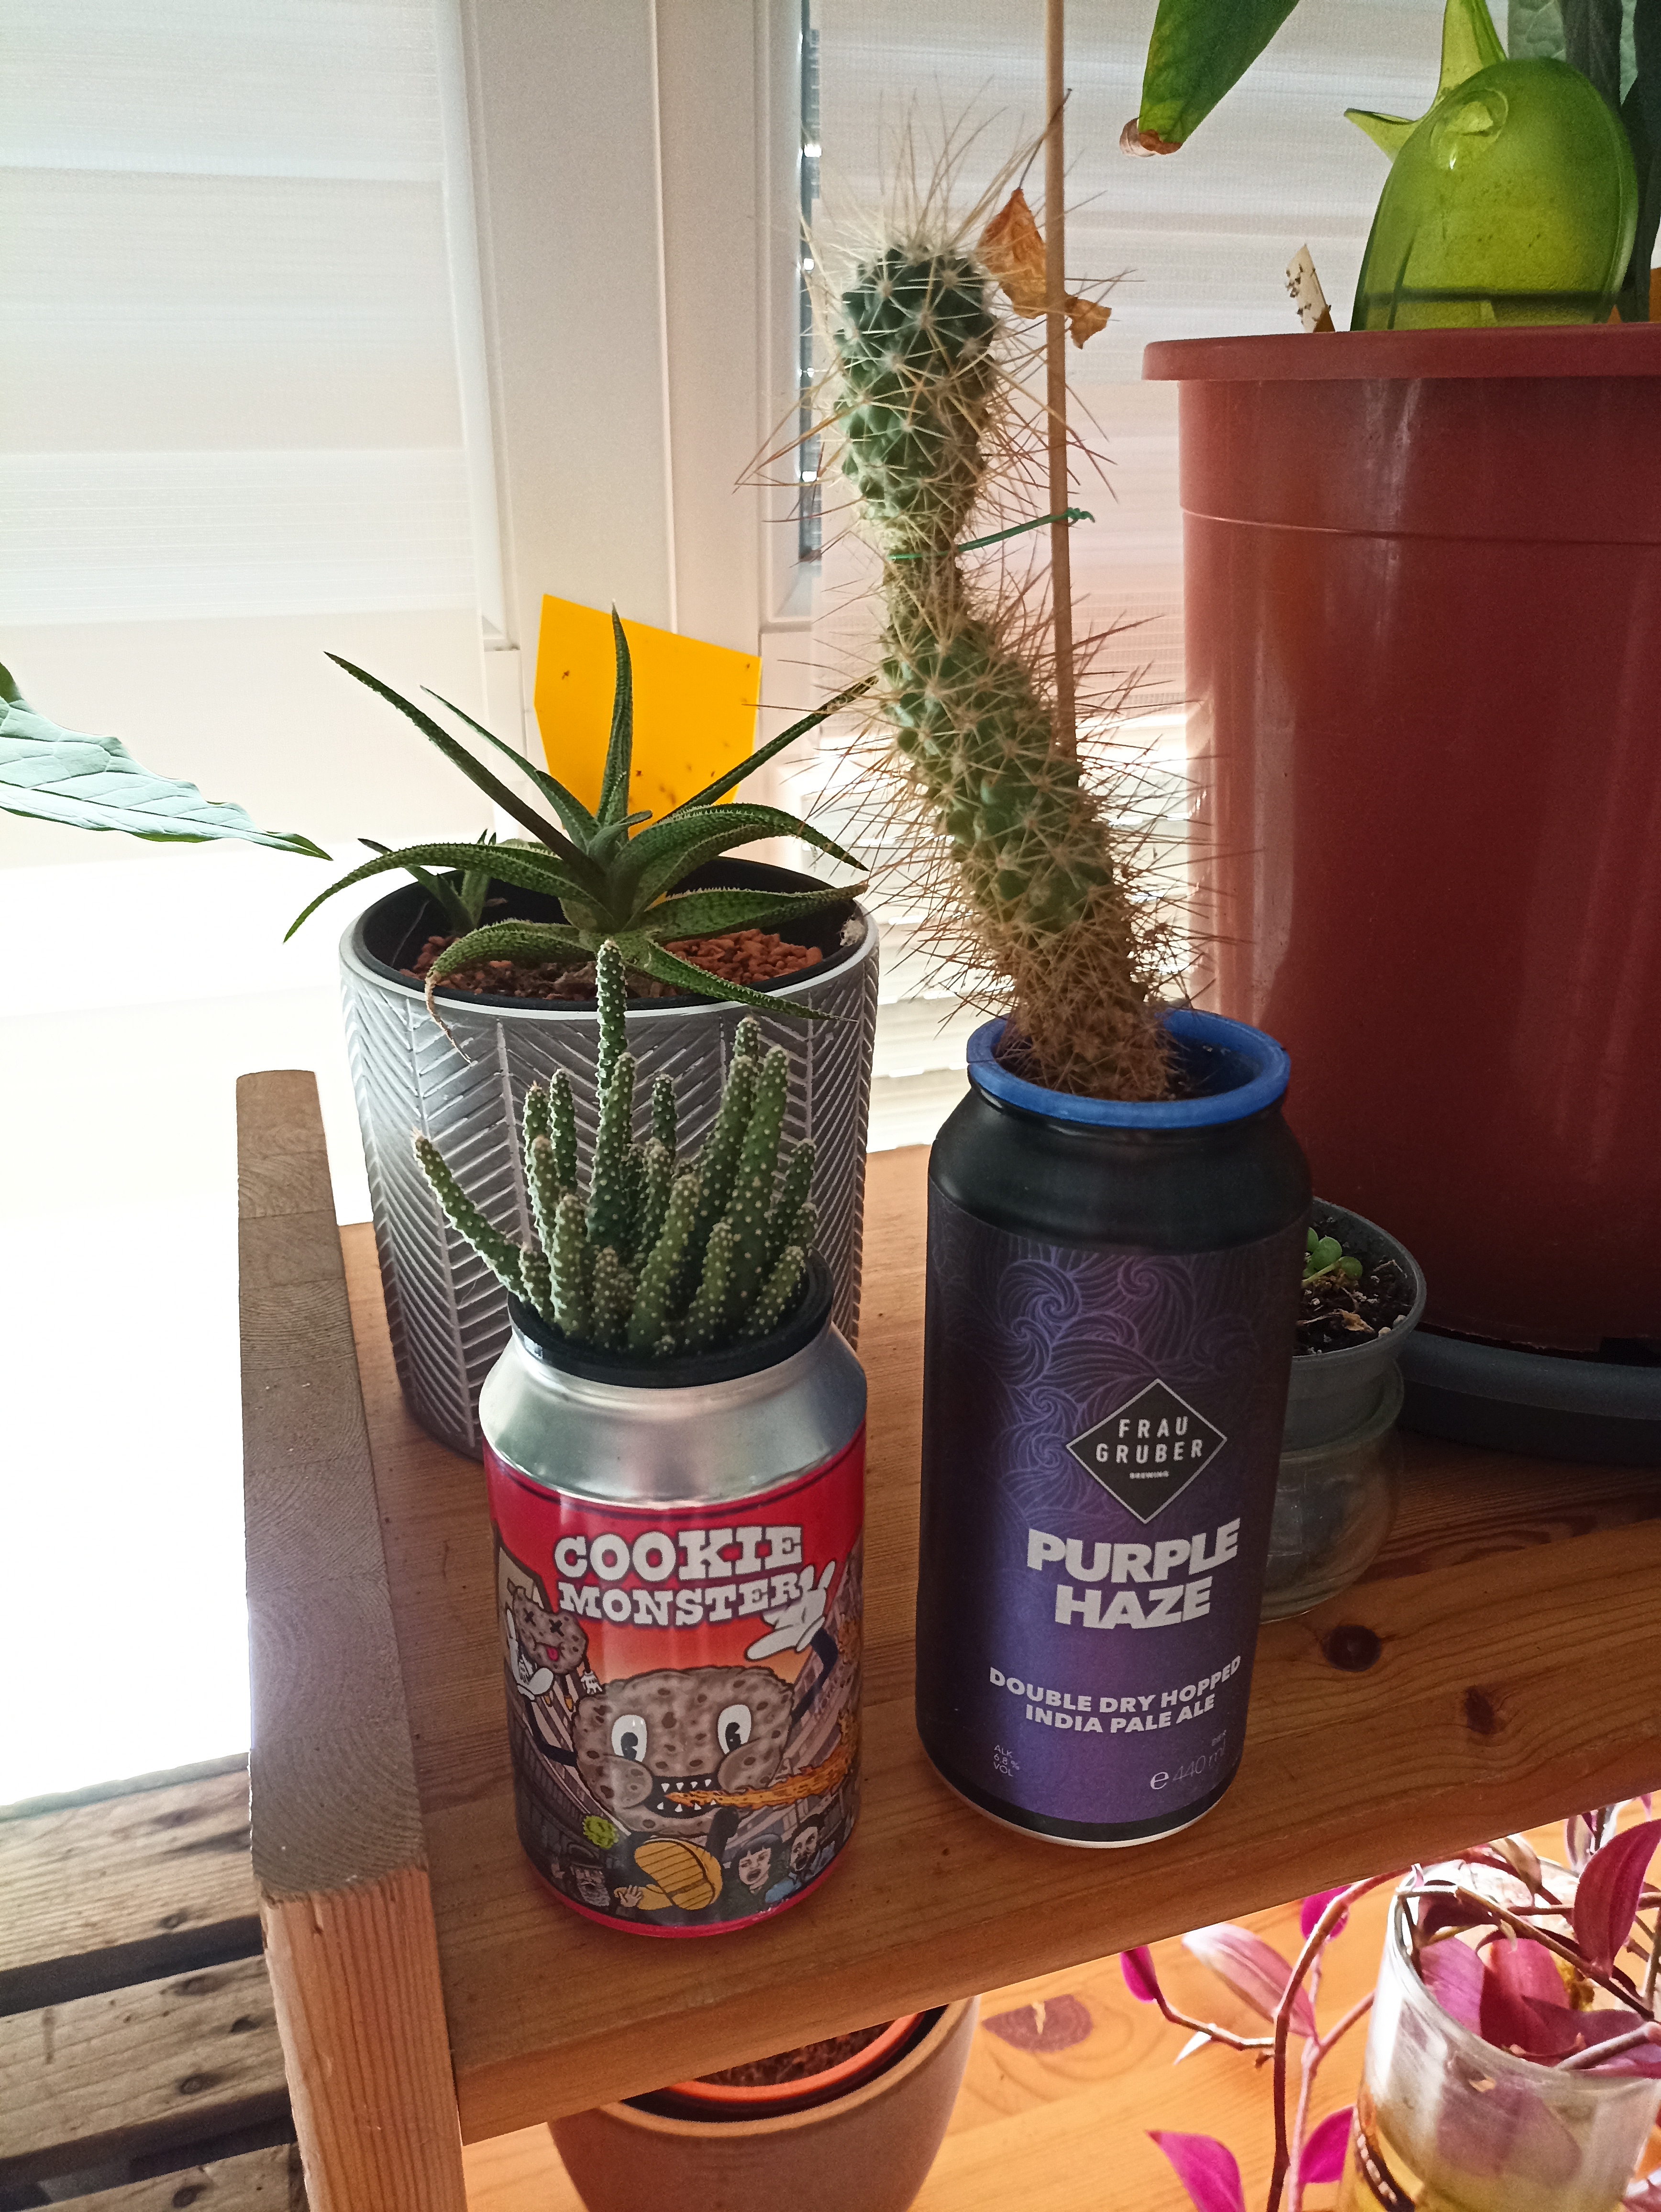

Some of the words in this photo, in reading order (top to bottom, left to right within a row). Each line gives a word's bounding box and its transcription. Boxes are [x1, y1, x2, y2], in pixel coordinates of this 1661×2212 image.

[1119, 1416, 1188, 1438] FRAU
[1096, 1439, 1203, 1464] GRUBER
[554, 1526, 802, 1582] COOKIE
[1027, 1518, 1240, 1583] PURPLE
[558, 1572, 800, 1626] MONSTER
[1055, 1576, 1212, 1629] HAZE
[990, 1667, 1091, 1712] DOUBLE
[1100, 1694, 1156, 1713] DRY
[1161, 1656, 1240, 1708] HOPPED
[1026, 1704, 1103, 1733] INDIA
[1110, 1711, 1171, 1733] PALE
[1176, 1693, 1215, 1724] ALE
[993, 1761, 1014, 1777] VOL
[994, 1745, 1013, 1759] ALK
[1173, 1755, 1206, 1781] 440
